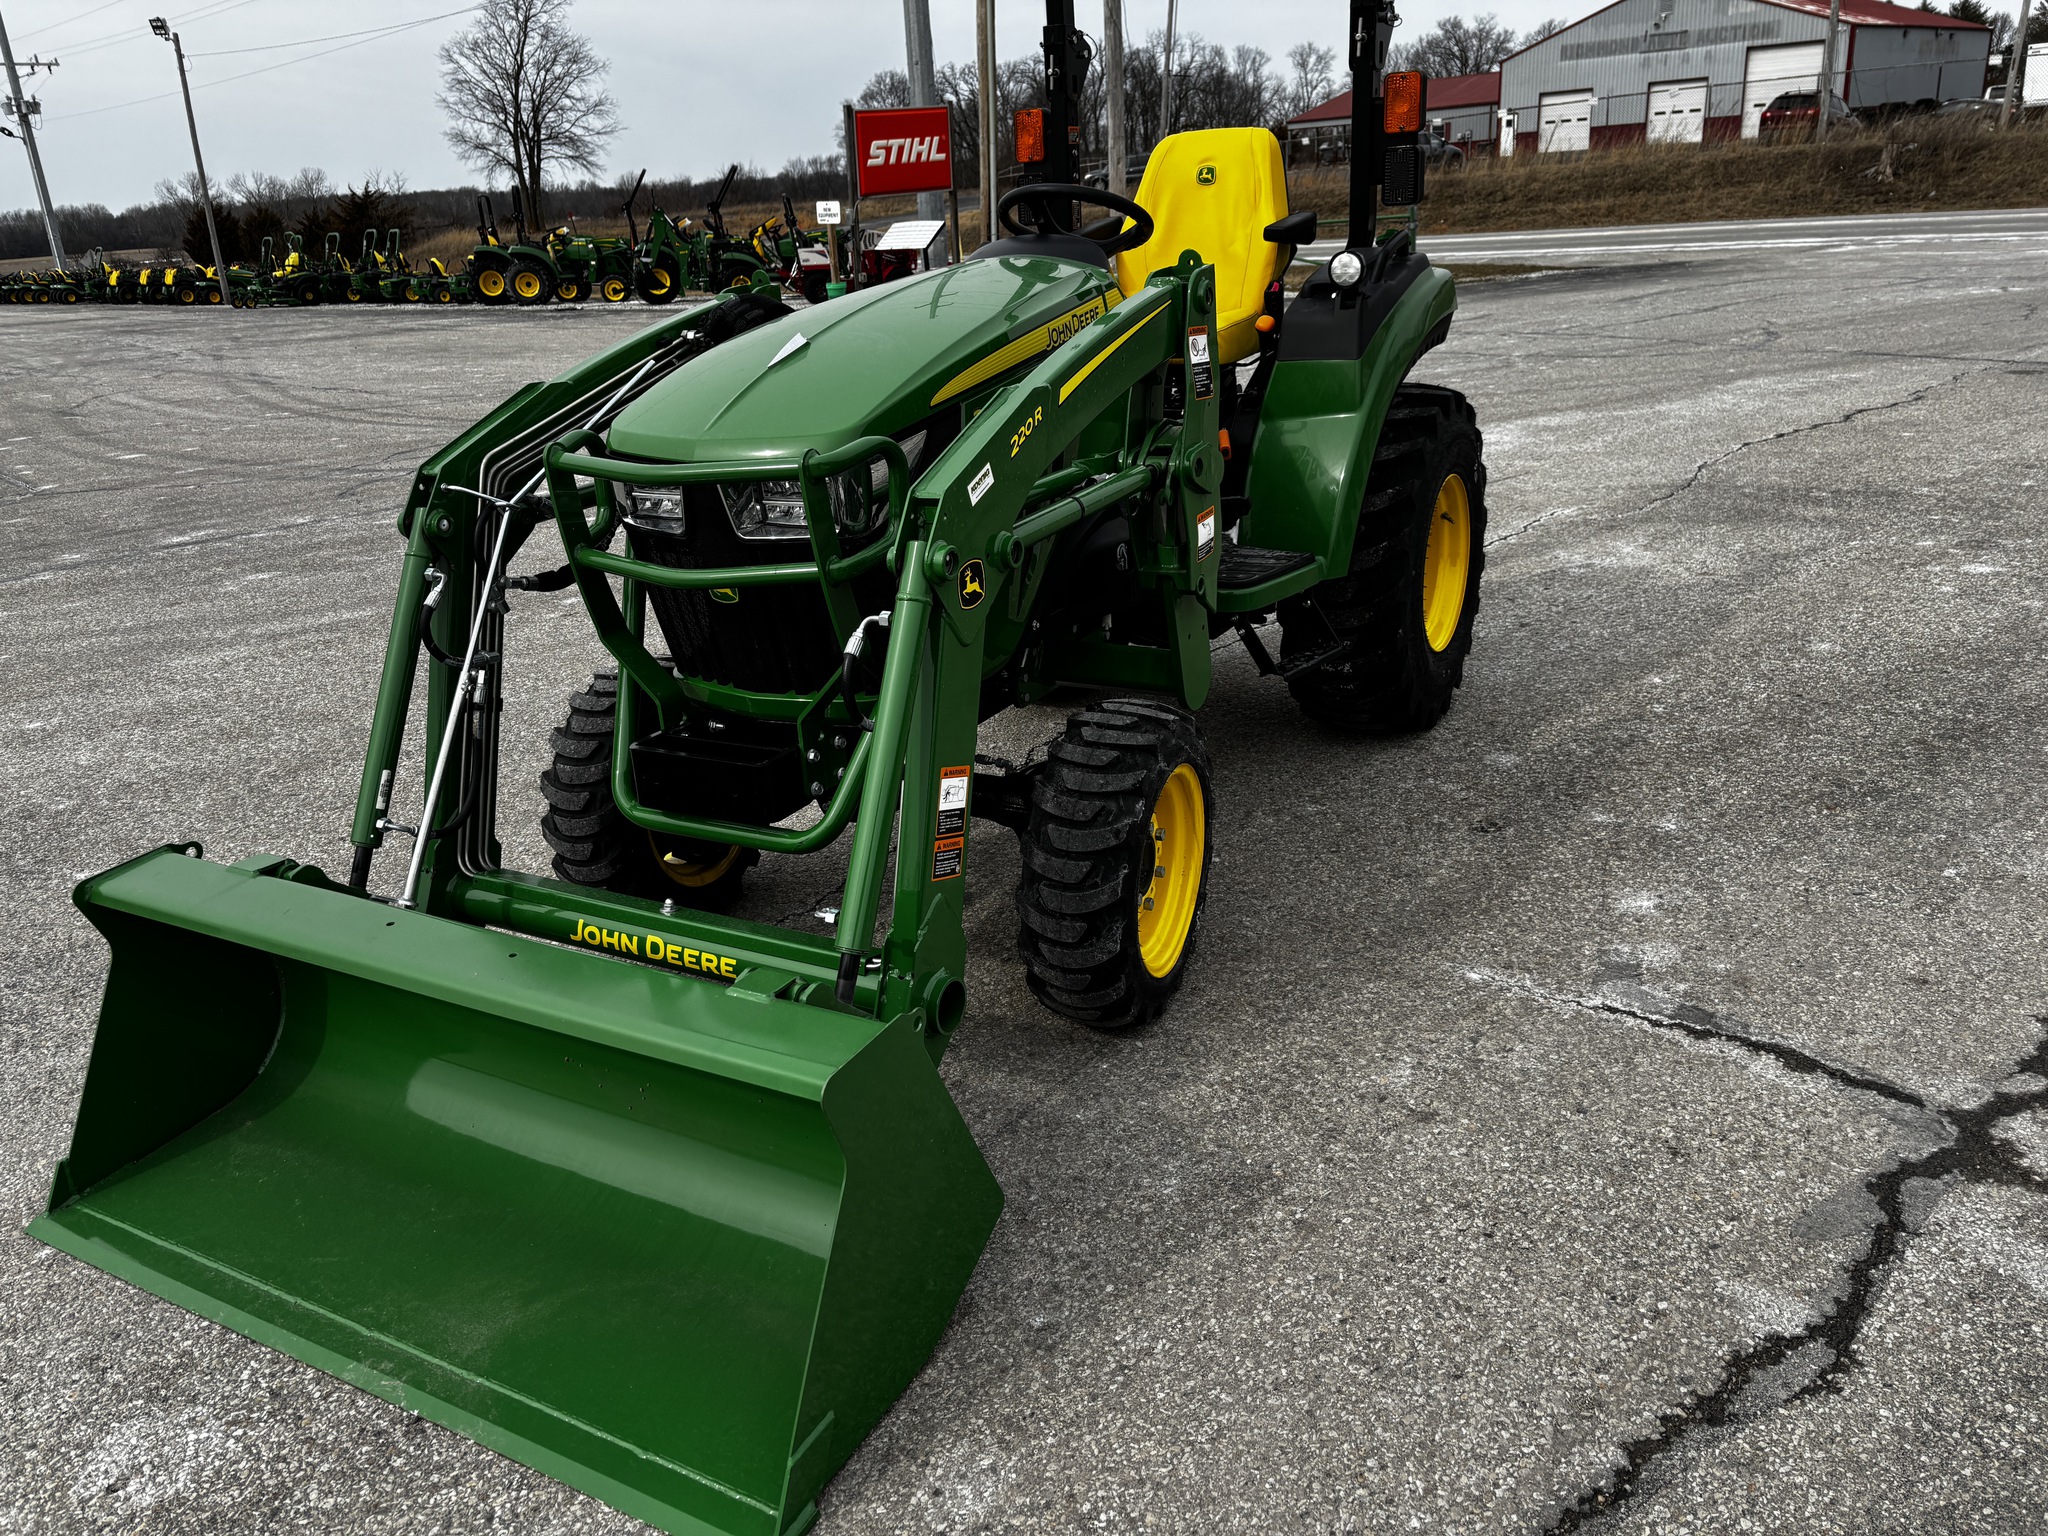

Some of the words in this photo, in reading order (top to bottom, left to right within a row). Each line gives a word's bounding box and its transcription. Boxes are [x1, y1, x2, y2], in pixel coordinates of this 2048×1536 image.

[867, 136, 946, 167] STIHL
[1046, 320, 1073, 349] JOHN
[949, 768, 967, 776] WARNING
[943, 841, 961, 849] WARNING
[570, 918, 639, 955] JOHN
[646, 934, 737, 979] DEERE
